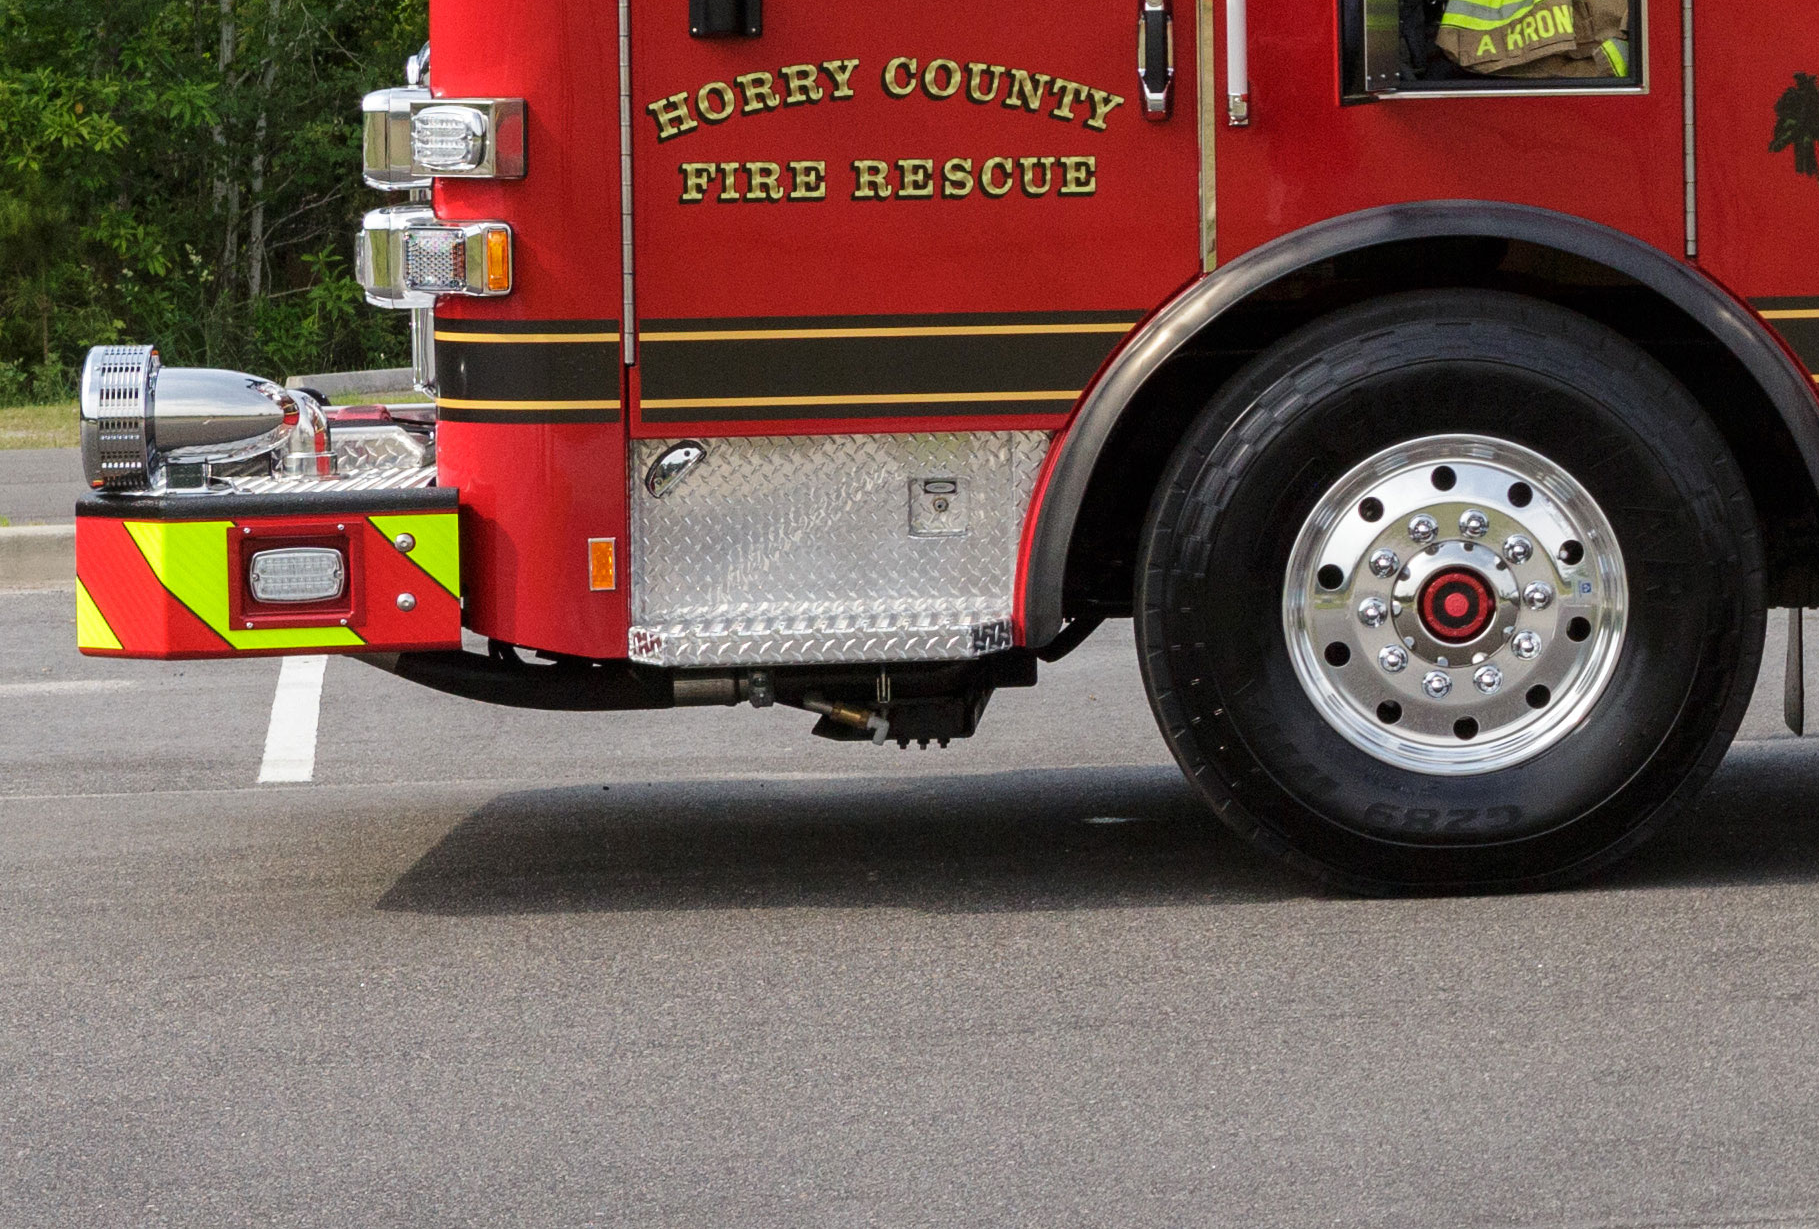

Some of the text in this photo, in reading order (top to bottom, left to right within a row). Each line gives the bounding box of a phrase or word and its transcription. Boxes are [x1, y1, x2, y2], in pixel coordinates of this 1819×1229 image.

[1476, 5, 1574, 56] A KRON
[645, 56, 1125, 144] HORRY COUNTY
[679, 155, 1097, 204] FIRE RESCUE
[1362, 801, 1523, 836] G289
